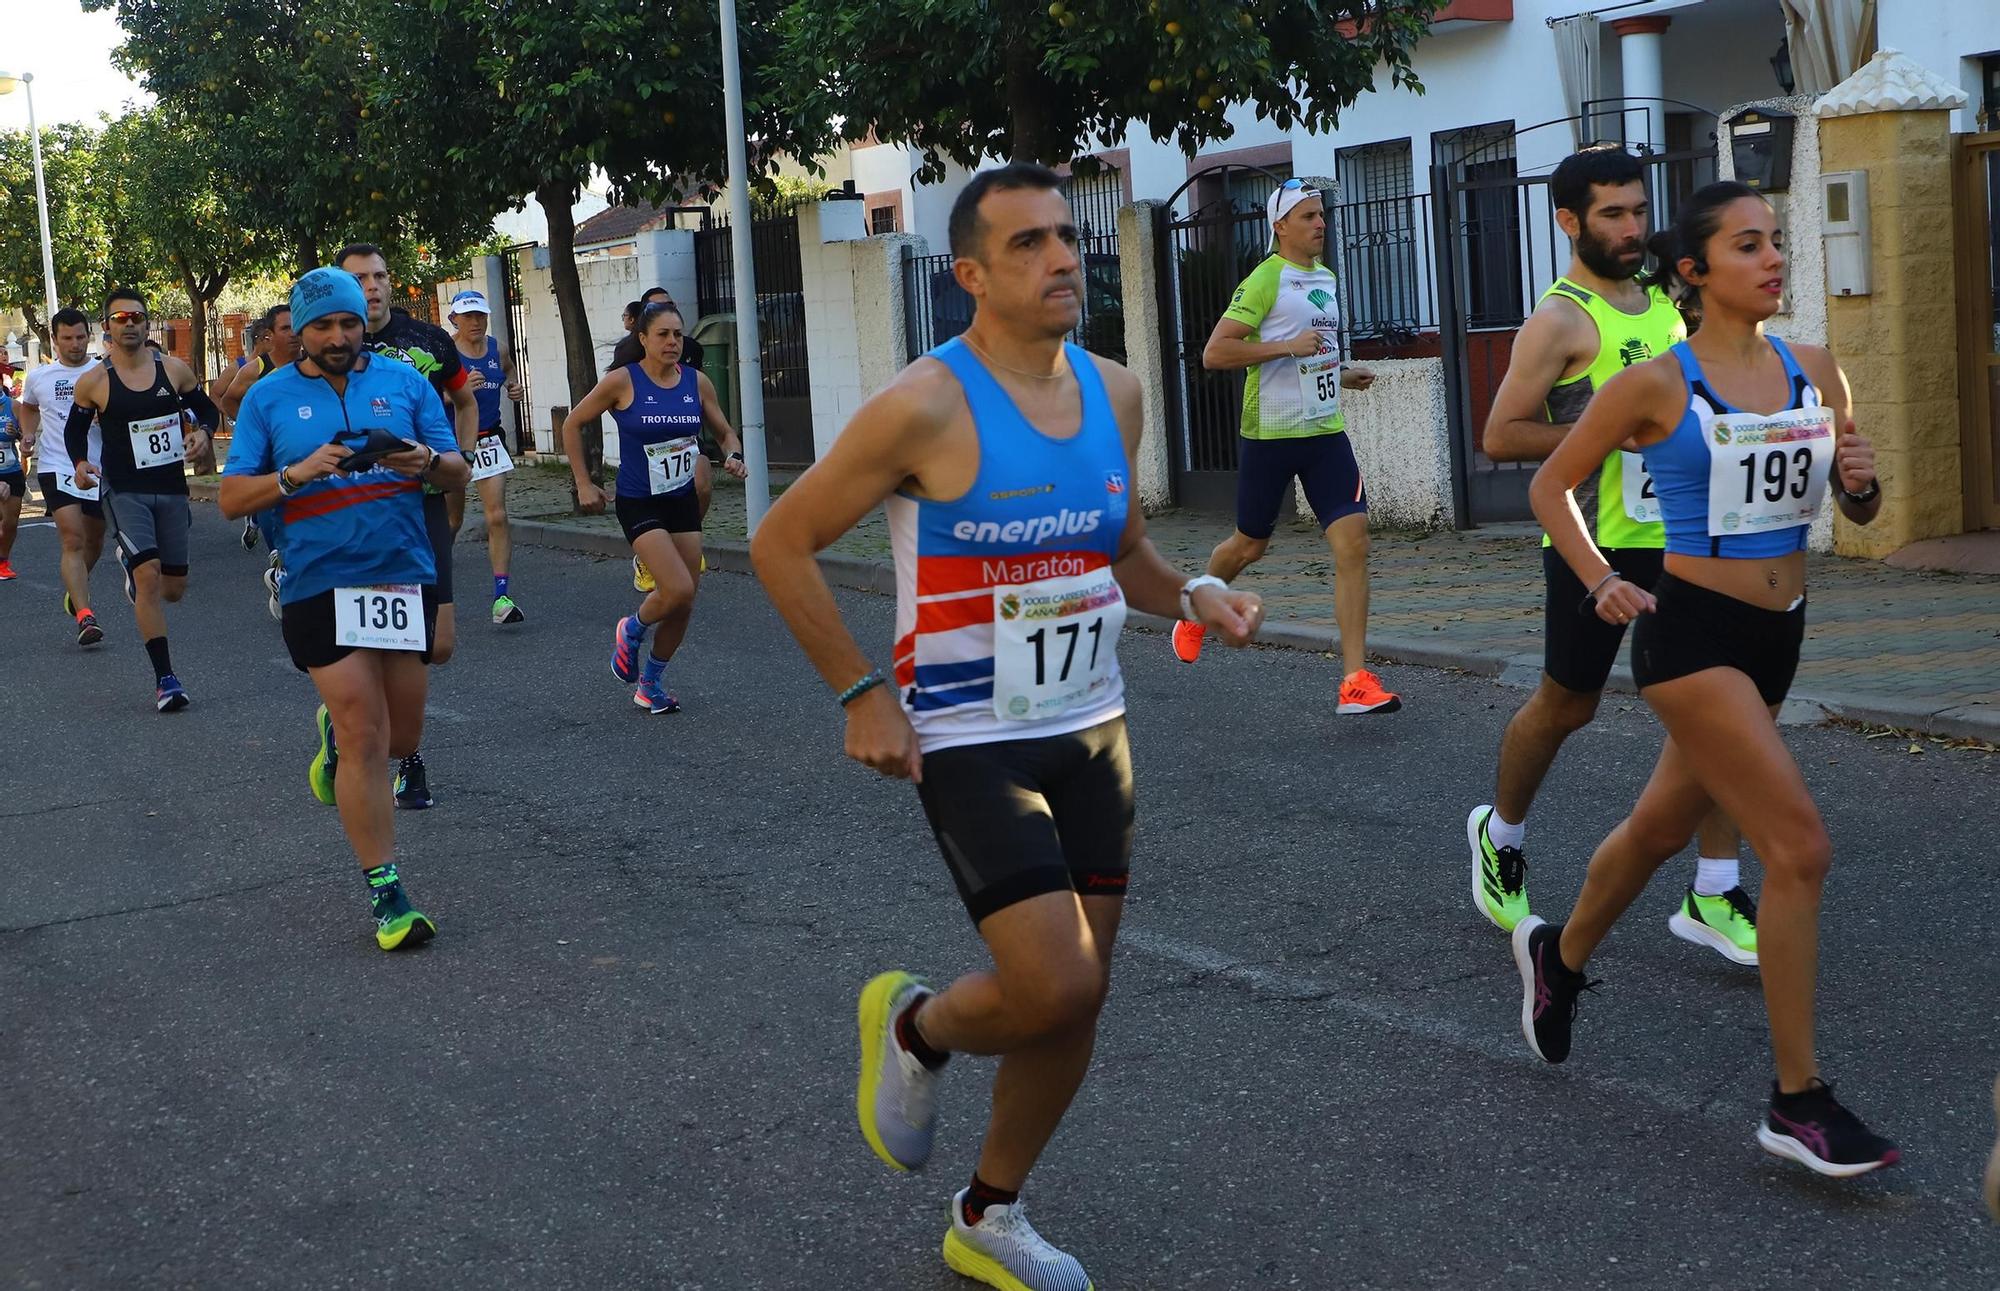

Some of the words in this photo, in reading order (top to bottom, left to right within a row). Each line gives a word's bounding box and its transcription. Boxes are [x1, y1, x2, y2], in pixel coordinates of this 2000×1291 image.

[1316, 373, 1336, 402] 55
[641, 415, 701, 424] TROTASIERRA
[149, 431, 171, 454] 83
[474, 448, 499, 470] 167
[660, 451, 692, 480] 176
[1740, 447, 1813, 504] 193
[953, 508, 1103, 546] enerplus
[982, 553, 1085, 584] Maratón
[353, 595, 408, 631] 136
[1026, 616, 1103, 686] 171
